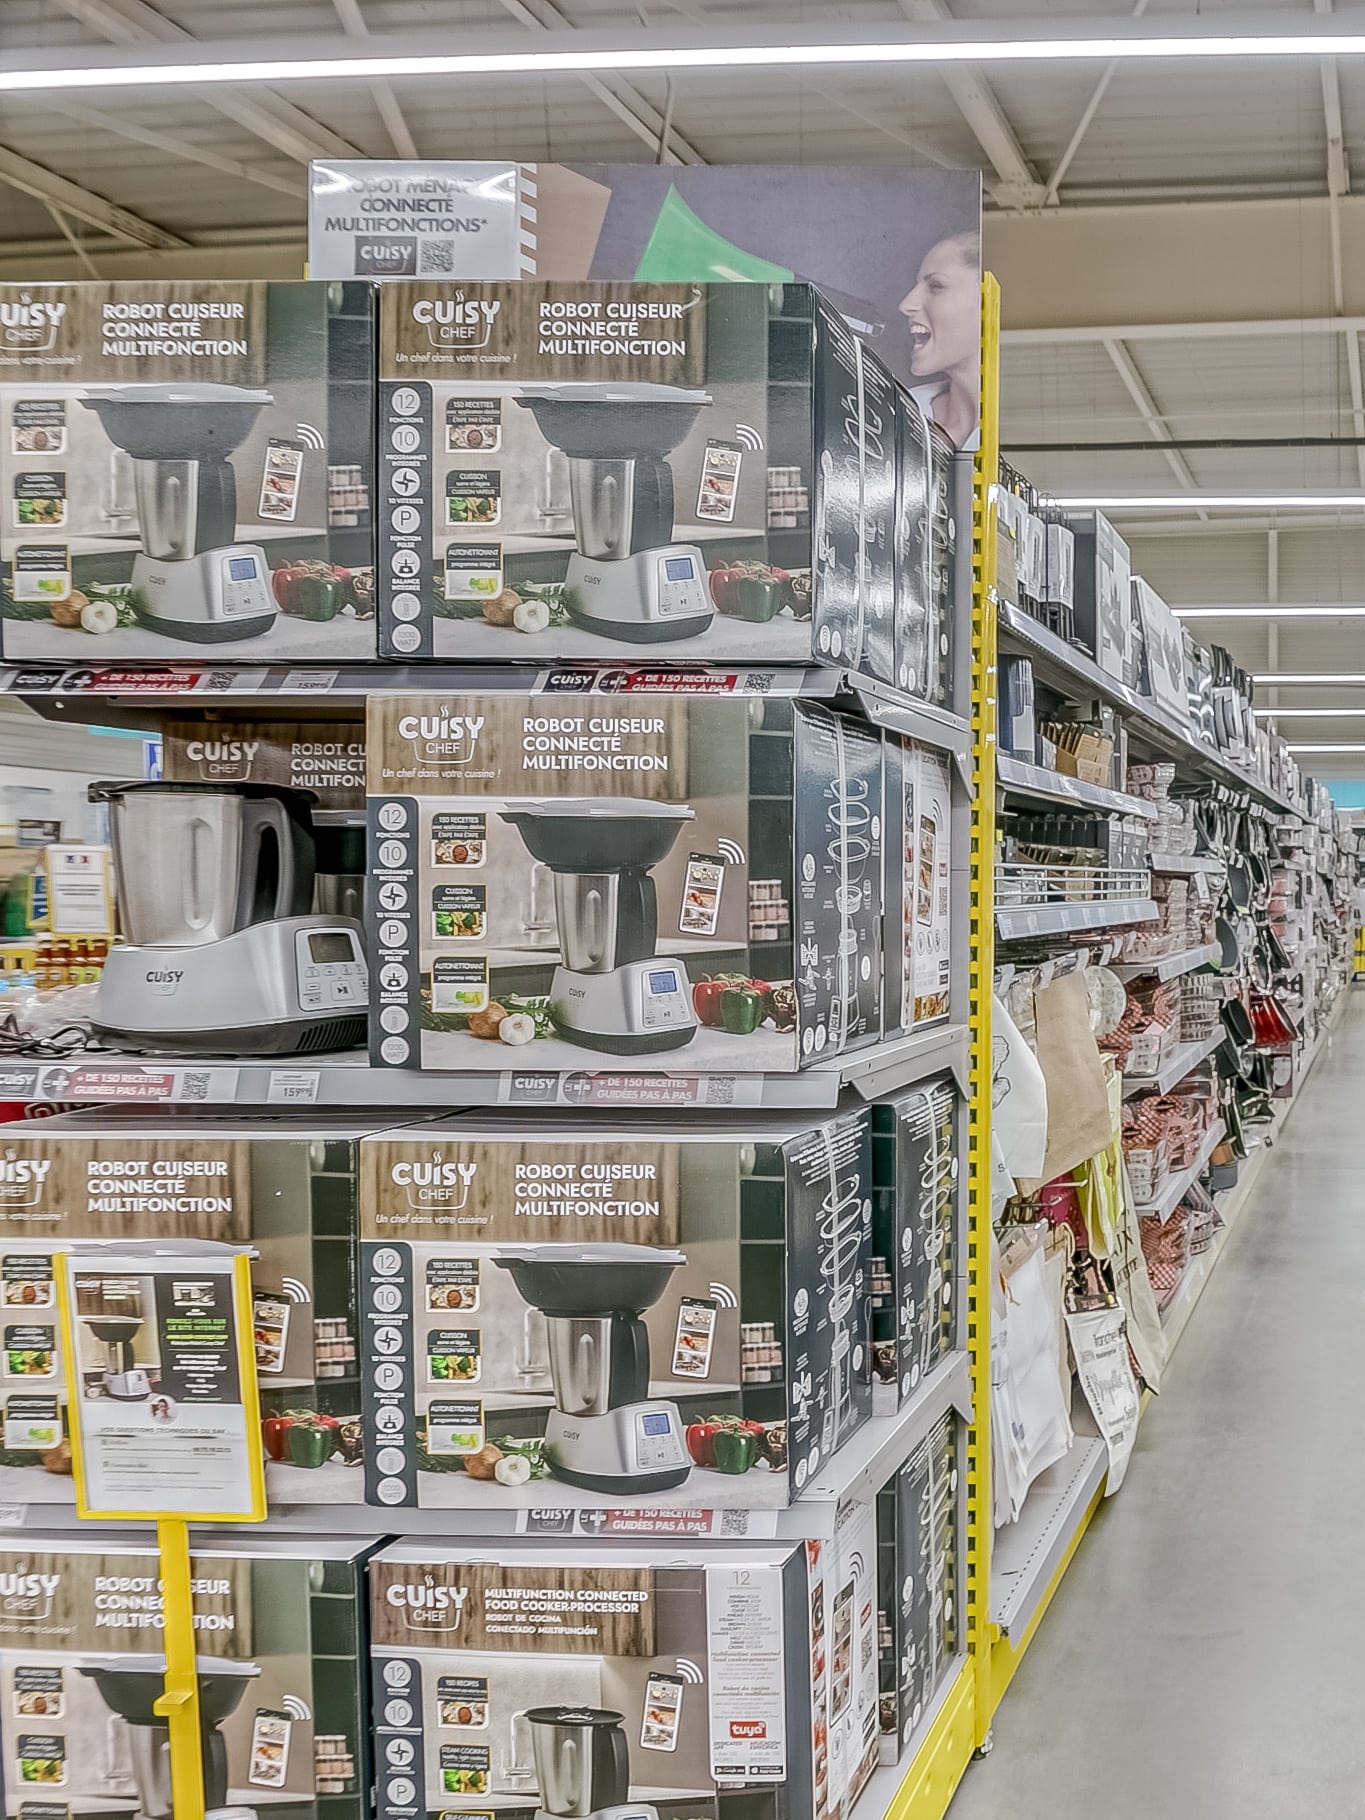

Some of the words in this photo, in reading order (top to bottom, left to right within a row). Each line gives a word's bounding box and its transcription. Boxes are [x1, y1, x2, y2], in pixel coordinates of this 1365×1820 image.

[102, 304, 165, 319] ROBOT
[168, 304, 244, 320] CUISEUR
[539, 302, 602, 318] ROBOT
[606, 302, 683, 318] CUISEUR
[440, 327, 476, 338] CHEF
[538, 318, 638, 337] CONNECTÉ
[102, 340, 248, 356] MULTIFONCTION
[538, 340, 686, 356] MULTIFONCTION
[398, 394, 415, 410] 12
[398, 432, 415, 446] 10
[401, 511, 411, 526] P
[522, 718, 584, 733] ROBOT
[588, 718, 664, 734] CUISEUR
[290, 744, 342, 756] ROBOT
[426, 742, 461, 754] CHEF
[522, 734, 621, 751] CONNECTÉ
[522, 754, 668, 771] MULTIFONCTION
[88, 1160, 149, 1176] ROBOT
[152, 1160, 228, 1176] CUISEUR
[515, 1164, 577, 1180] ROBOT
[580, 1164, 656, 1180] CUISEUR
[88, 1176, 186, 1194] CONNECTÉ
[514, 1179, 613, 1198] CONNECTÉ
[418, 1188, 454, 1200] CHEF
[88, 1197, 232, 1213] MULTIFONCTION
[514, 1200, 660, 1216] MULTIFONCTION
[623, 1510, 636, 1518] DE
[640, 1510, 657, 1518] 150
[658, 1510, 702, 1519] RECETTES
[612, 1518, 654, 1530] GUIDÉES
[656, 1520, 674, 1531] PAS
[676, 1518, 687, 1531] À
[688, 1520, 708, 1532] PAS
[96, 1577, 154, 1592] ROBOT
[484, 1588, 574, 1600] MULTIFUNCTION
[576, 1590, 648, 1602] CONNECTED
[484, 1600, 518, 1610] FOOD
[520, 1600, 640, 1613] COOKER-PROCESSOR
[96, 1614, 235, 1630] MULTIFOTION
[413, 1609, 446, 1622] CHEF
[486, 1614, 513, 1622] ROBOT
[515, 1614, 526, 1622] DE
[528, 1614, 562, 1623] COCINA
[486, 1625, 536, 1634] CONECTADO
[538, 1626, 598, 1636] MULTIFUNCIÓN
[732, 1724, 763, 1736] tuya
